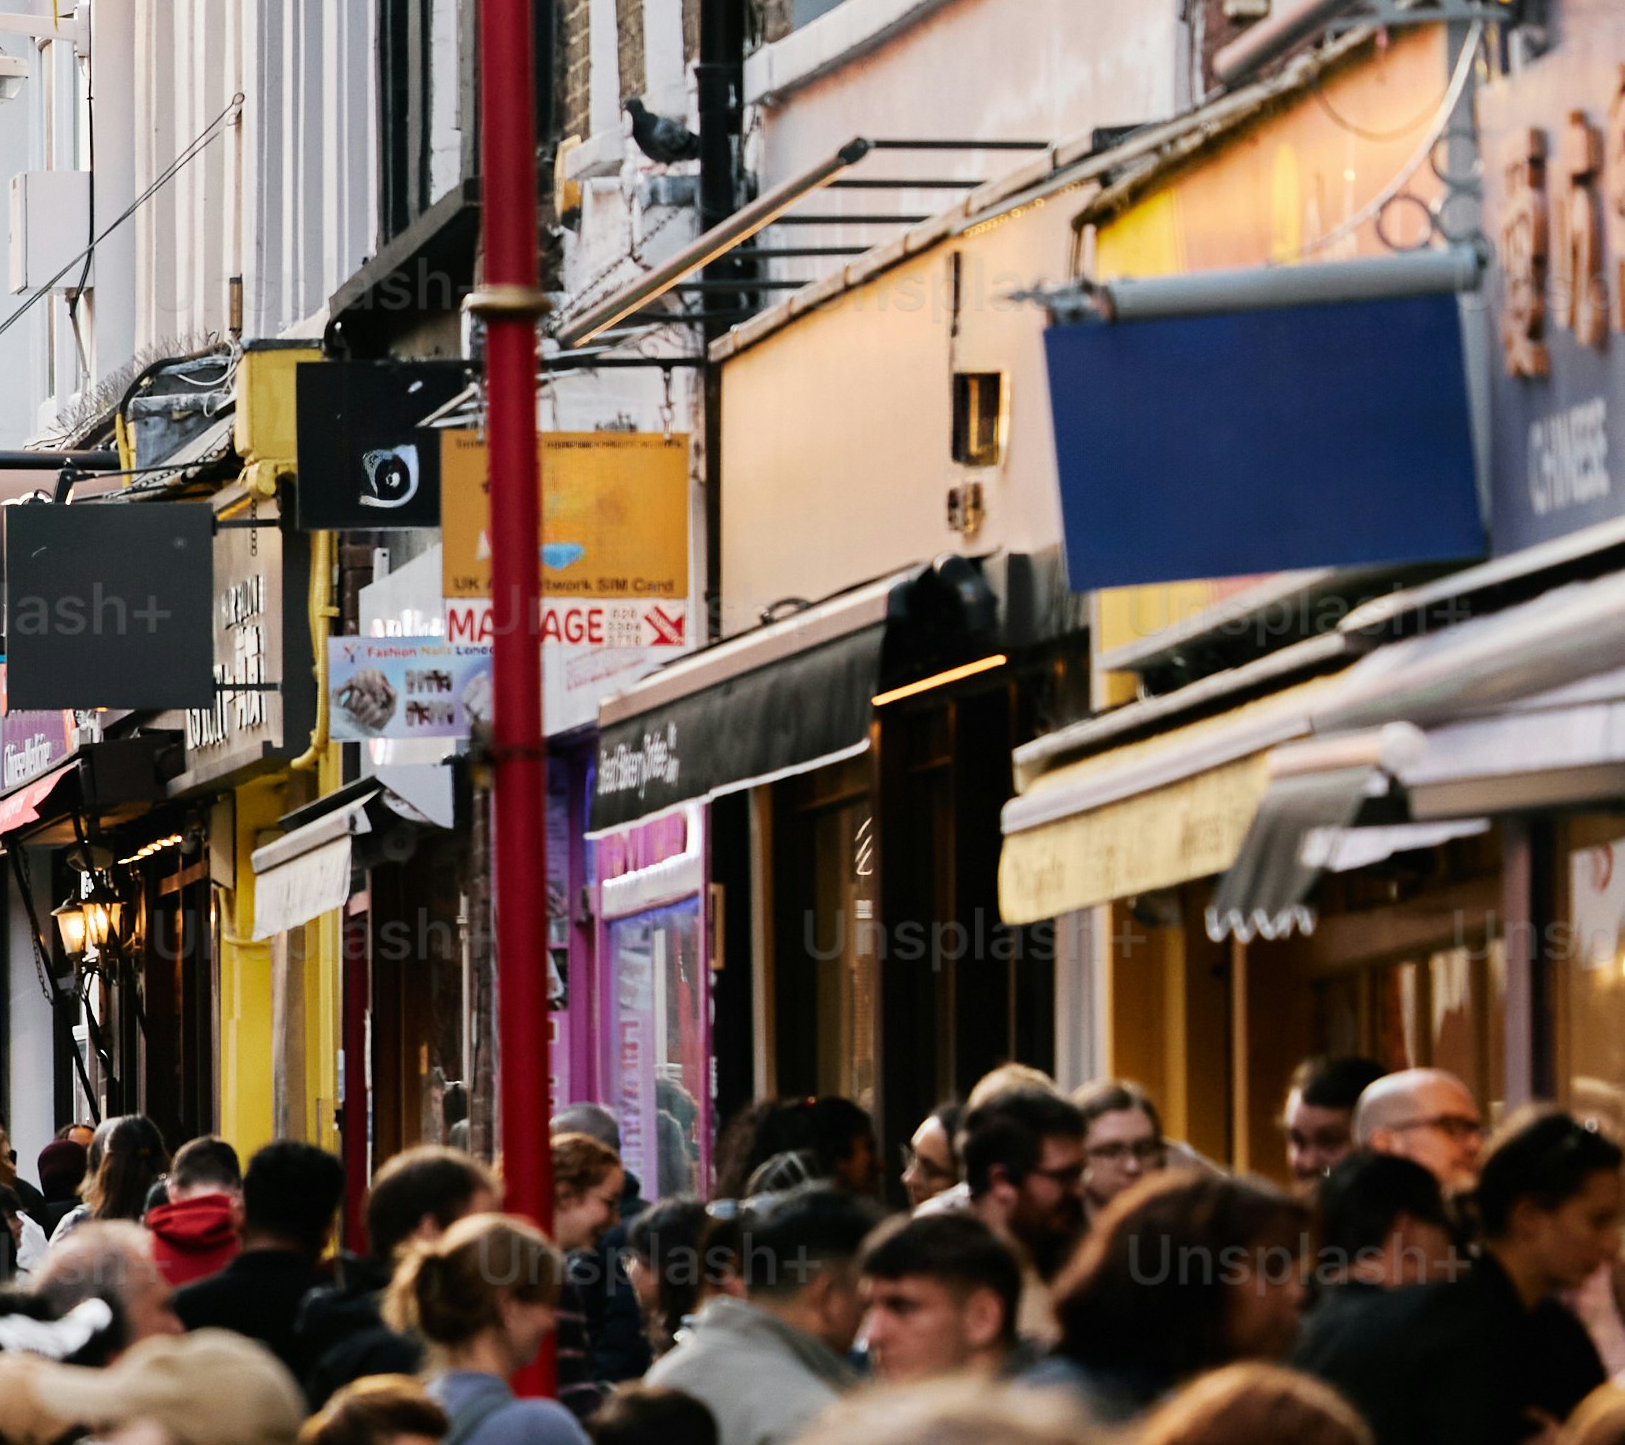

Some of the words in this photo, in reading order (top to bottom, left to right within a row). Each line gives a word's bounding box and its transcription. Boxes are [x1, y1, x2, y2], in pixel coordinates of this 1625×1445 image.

[453, 580, 479, 591] UK
[596, 577, 628, 592] SIM
[634, 577, 675, 592] Card
[367, 647, 417, 658] Fashion
